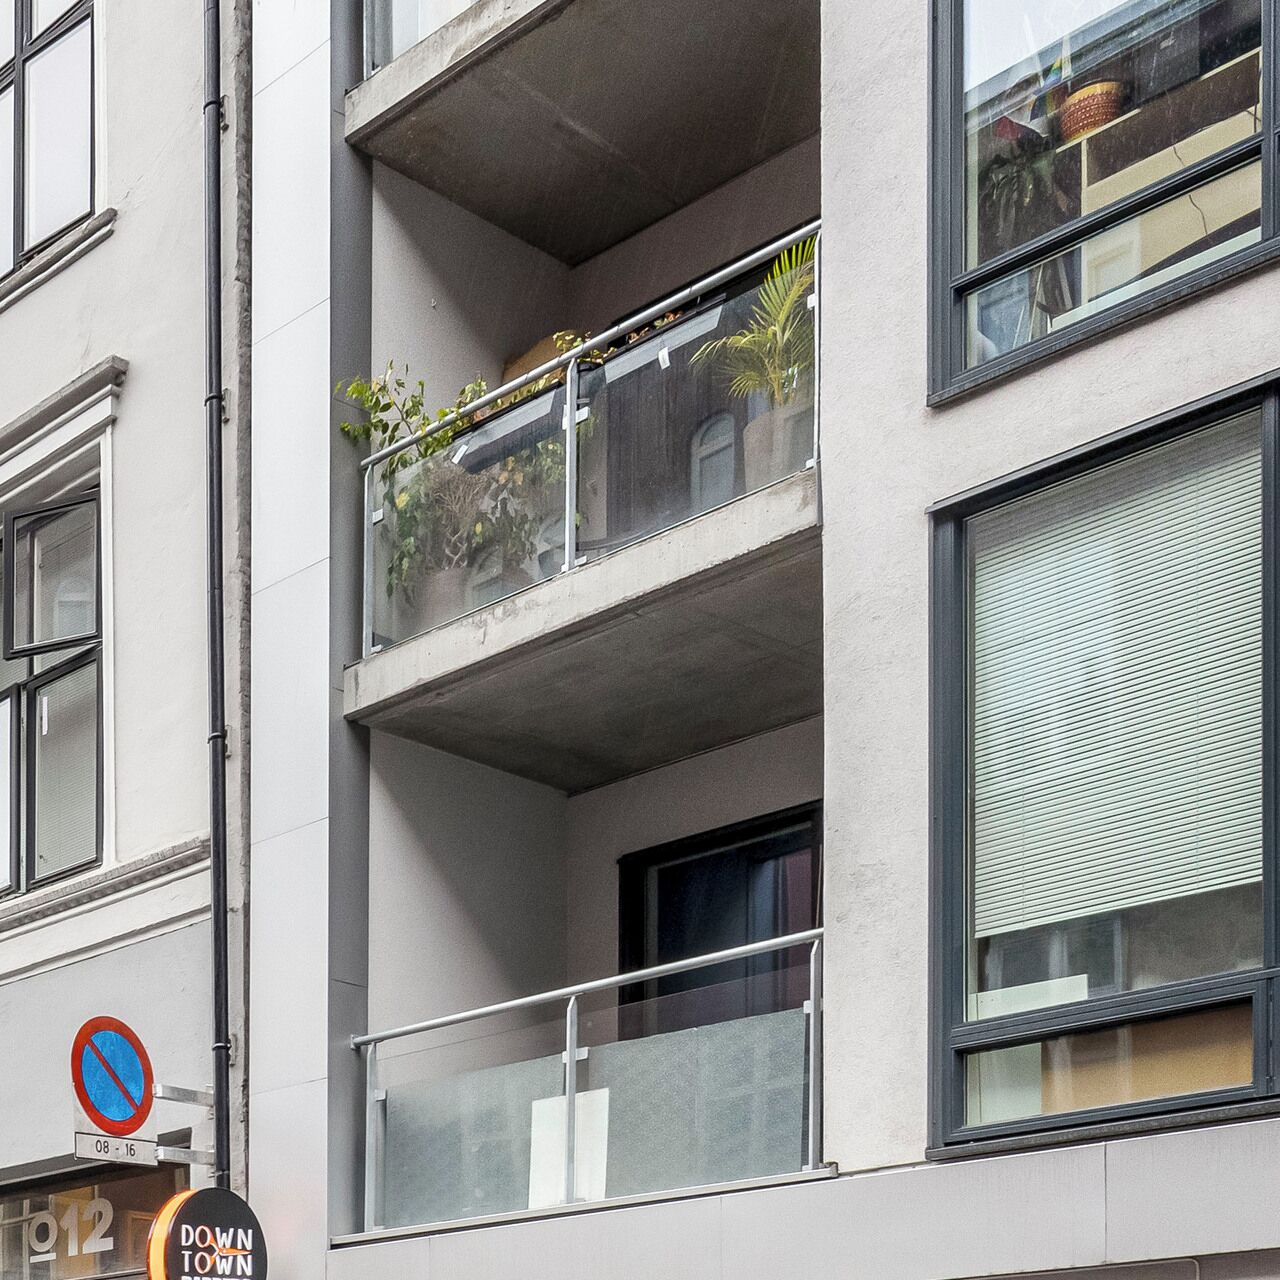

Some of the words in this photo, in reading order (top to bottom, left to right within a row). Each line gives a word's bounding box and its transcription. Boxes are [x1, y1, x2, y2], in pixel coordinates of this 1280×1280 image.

[95, 1139, 110, 1154] 08
[125, 1143, 137, 1157] 16
[181, 1223, 253, 1251] DOWN
[181, 1250, 253, 1276] TOWN
